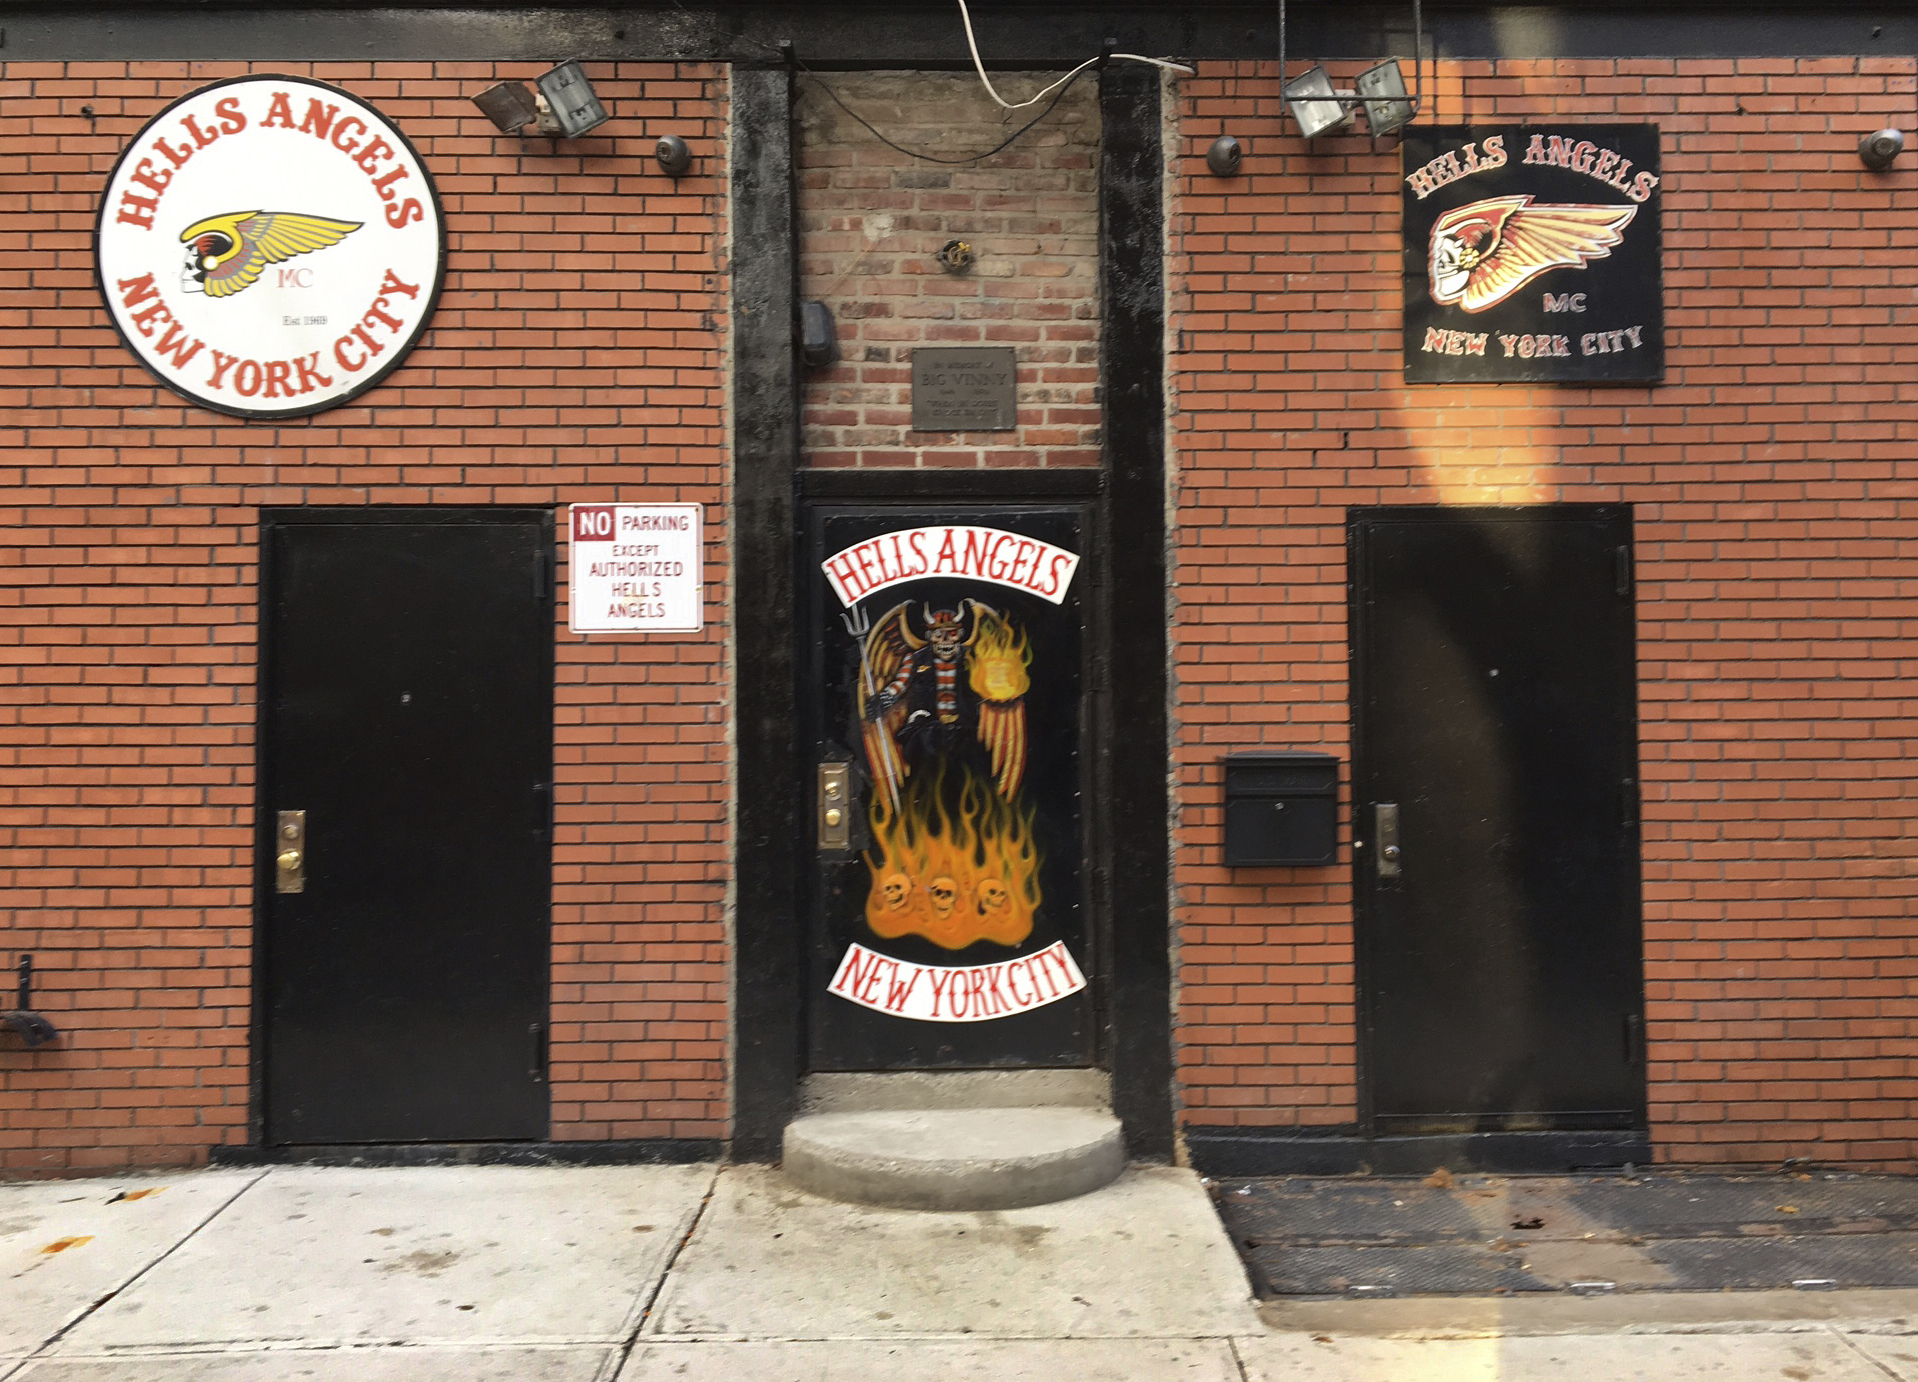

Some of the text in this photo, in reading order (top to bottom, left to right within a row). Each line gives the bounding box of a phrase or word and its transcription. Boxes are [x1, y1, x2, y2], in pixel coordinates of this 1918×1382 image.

[116, 92, 424, 231] HELLS ANGELS
[1405, 133, 1659, 202] HELLS ANGELS
[277, 268, 313, 288] MC
[1543, 292, 1587, 313] MC
[117, 268, 420, 398] NEW YORK CITY
[1421, 325, 1643, 358] NEW YORK CITY
[921, 373, 1008, 386] BIG VINNY
[580, 511, 689, 535] NO PARKING
[612, 544, 660, 557] EXCEPT
[589, 561, 684, 577] AUTHORIZED
[827, 528, 1072, 603] HELLS ANGELS
[611, 582, 661, 597] HELLS
[607, 602, 666, 618] ANGELS
[834, 942, 1078, 1018] NEW YORK CITY
